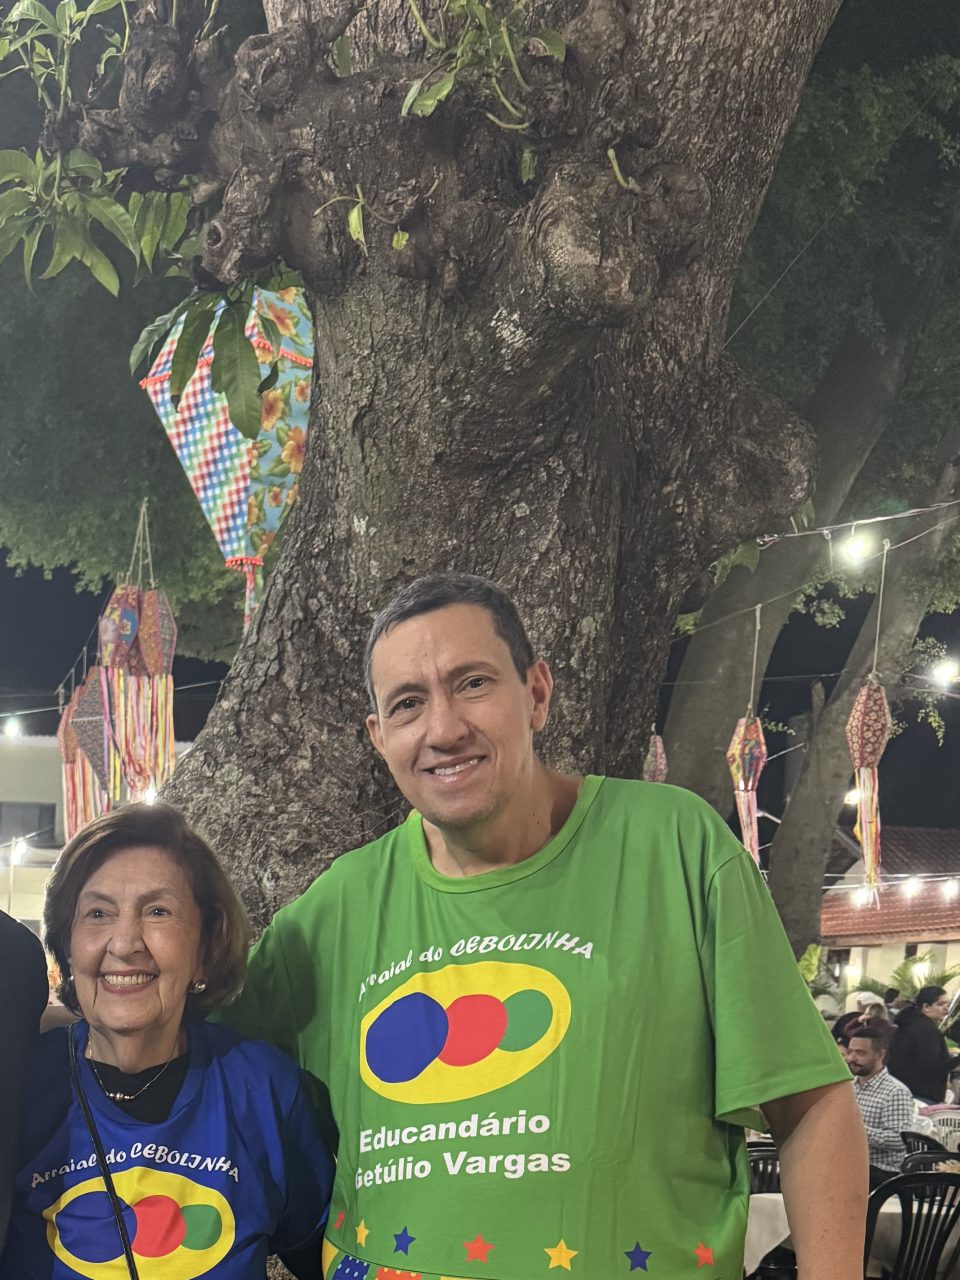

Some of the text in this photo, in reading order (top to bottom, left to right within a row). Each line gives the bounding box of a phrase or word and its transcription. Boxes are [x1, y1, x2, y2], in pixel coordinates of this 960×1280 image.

[358, 930, 595, 1003] Arraial do CEBOLINHA
[359, 1110, 551, 1153] Educandário
[31, 1142, 240, 1189] Arraial do CEBOLINHA
[355, 1149, 571, 1190] Getúlio Vargas
